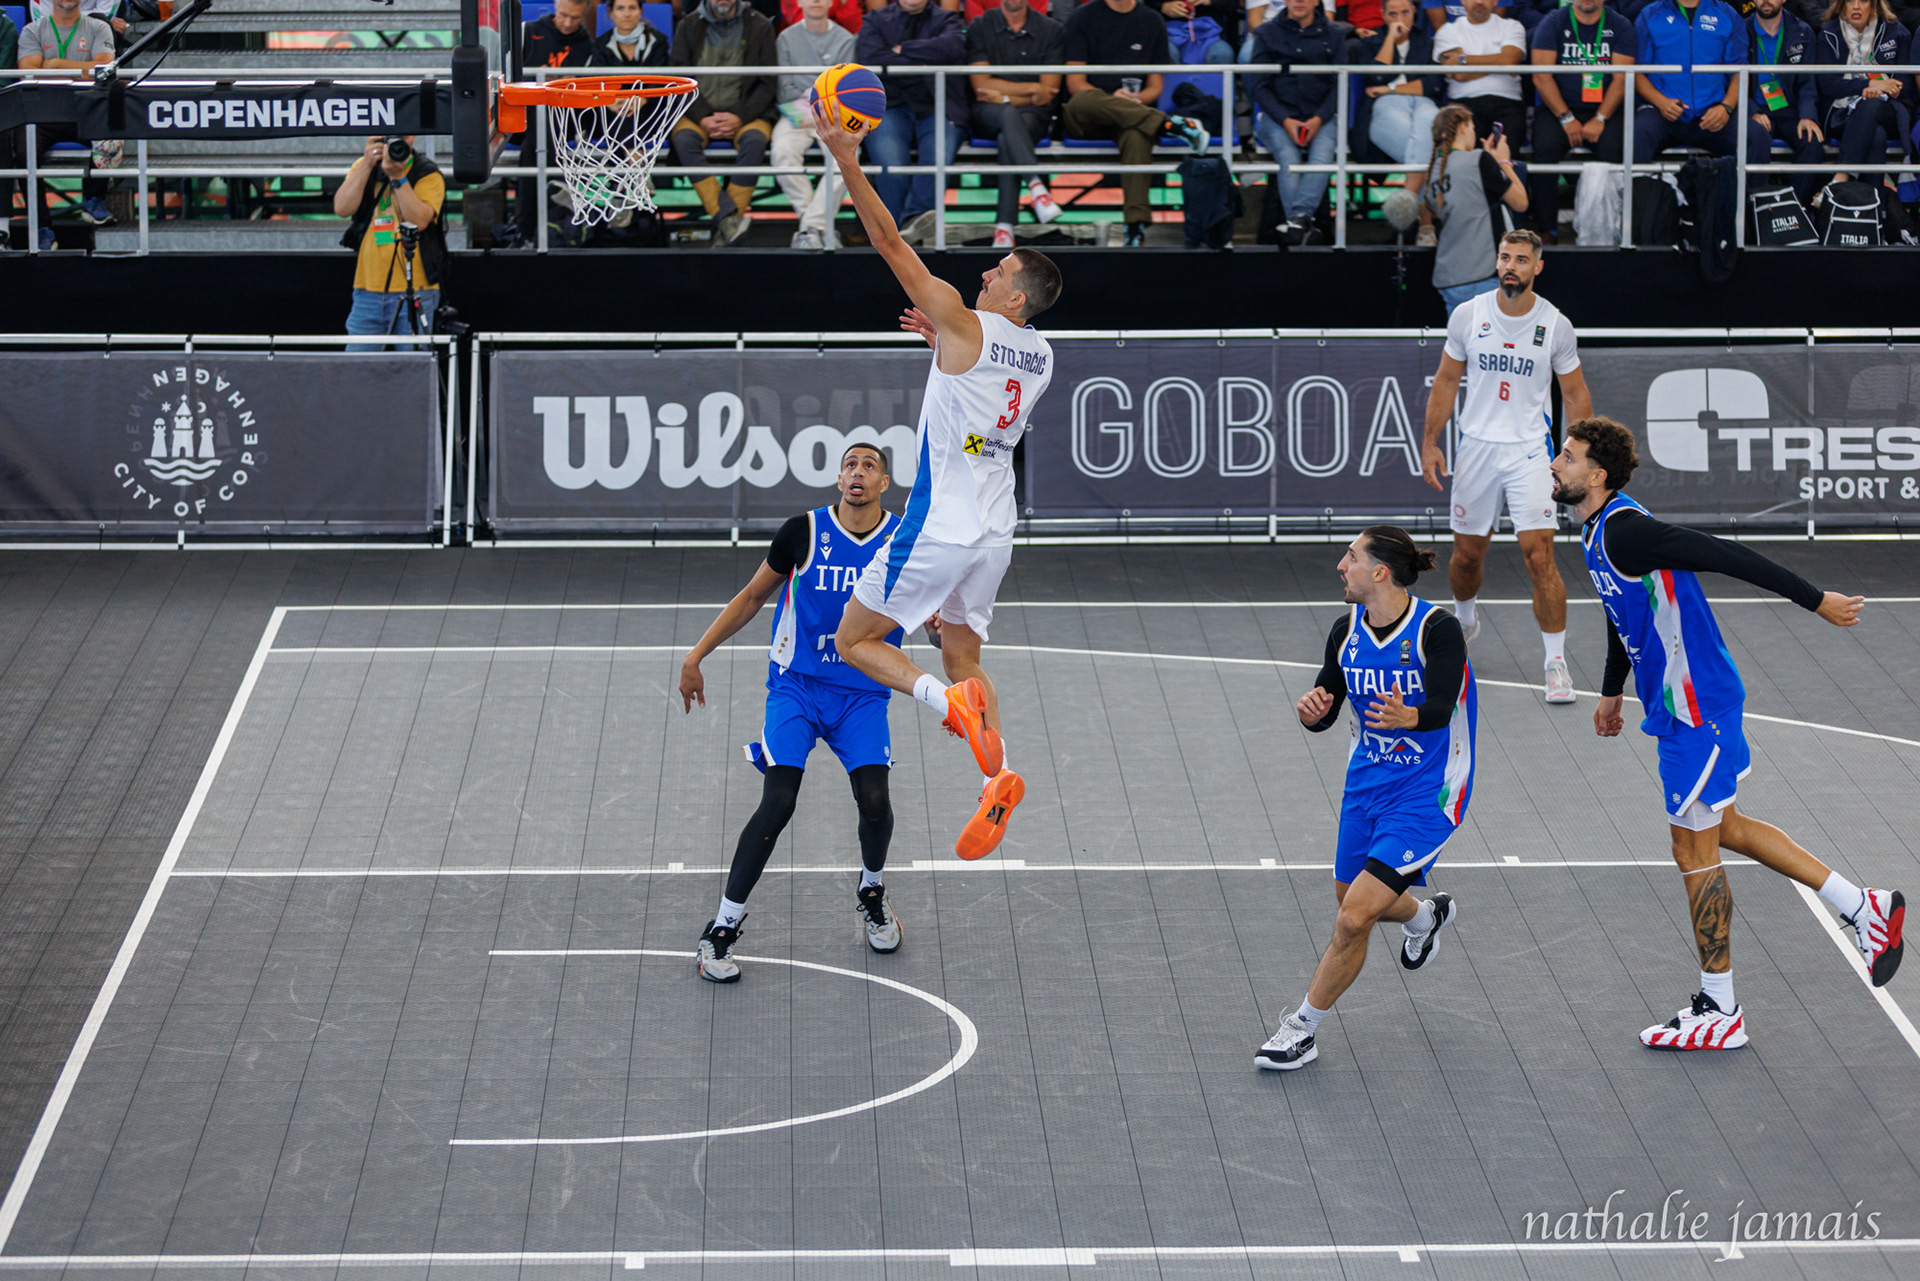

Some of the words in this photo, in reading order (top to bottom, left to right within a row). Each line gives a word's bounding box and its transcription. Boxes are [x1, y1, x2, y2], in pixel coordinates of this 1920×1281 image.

[148, 98, 396, 129] COPENHAGEN
[1771, 216, 1799, 228] ITALIA
[1840, 234, 1869, 245] ITALIA
[1479, 353, 1535, 377] SRBIJA
[996, 378, 1021, 429] 3
[1498, 381, 1511, 401] 6
[153, 366, 258, 501] COPENHAGEN
[533, 391, 918, 490] Wilson
[114, 462, 161, 510] CITY
[1799, 476, 1890, 500] SPORT
[1900, 477, 1920, 500] &
[174, 498, 206, 517] OF
[815, 565, 867, 592] ITA
[1342, 665, 1424, 696] ITALIA
